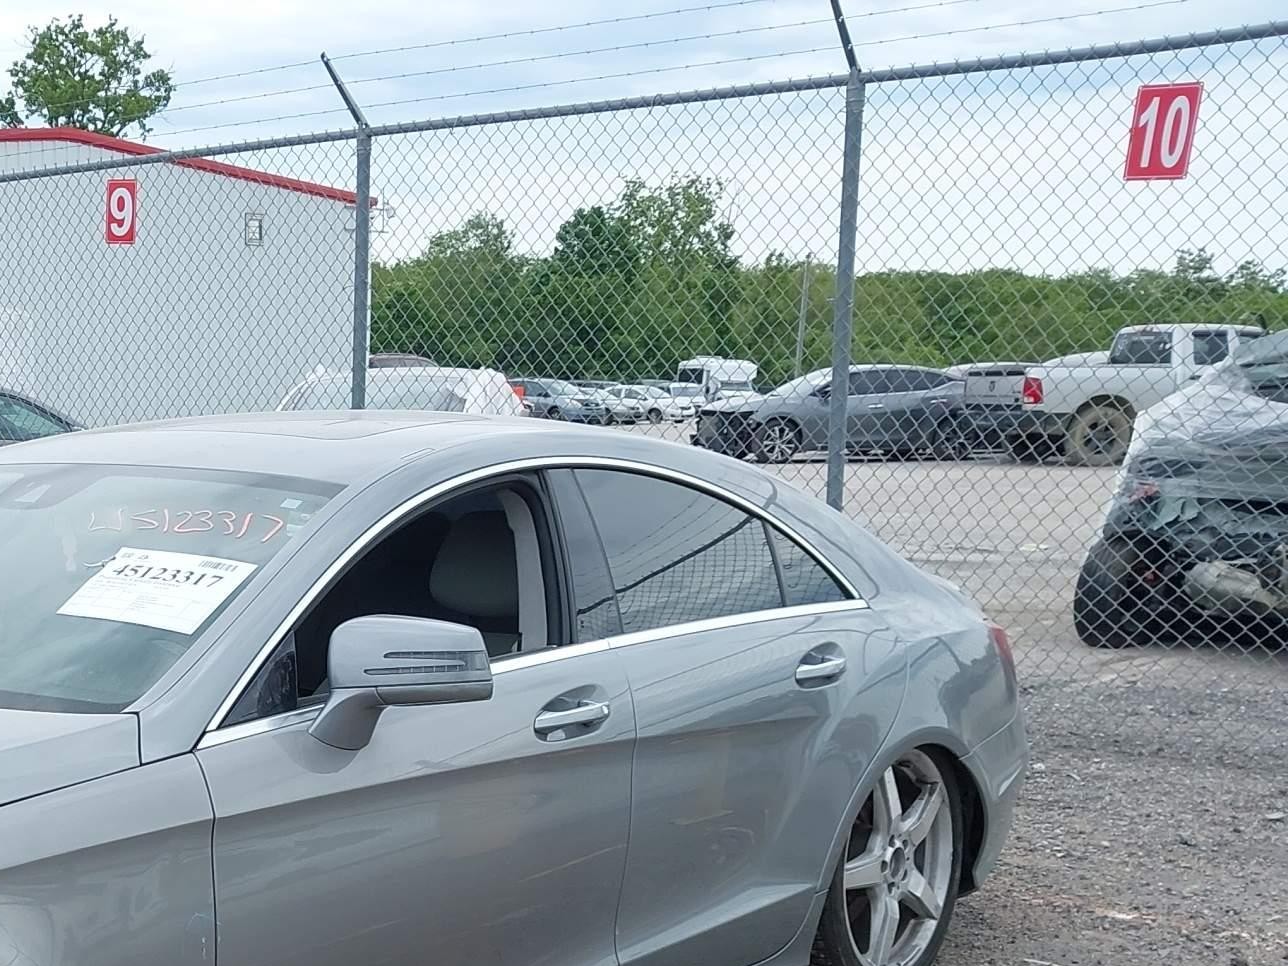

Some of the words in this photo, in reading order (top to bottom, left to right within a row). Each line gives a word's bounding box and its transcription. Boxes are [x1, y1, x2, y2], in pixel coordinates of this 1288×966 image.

[1138, 95, 1190, 168] 10
[110, 187, 133, 237] 9
[112, 564, 225, 588] 45123317
